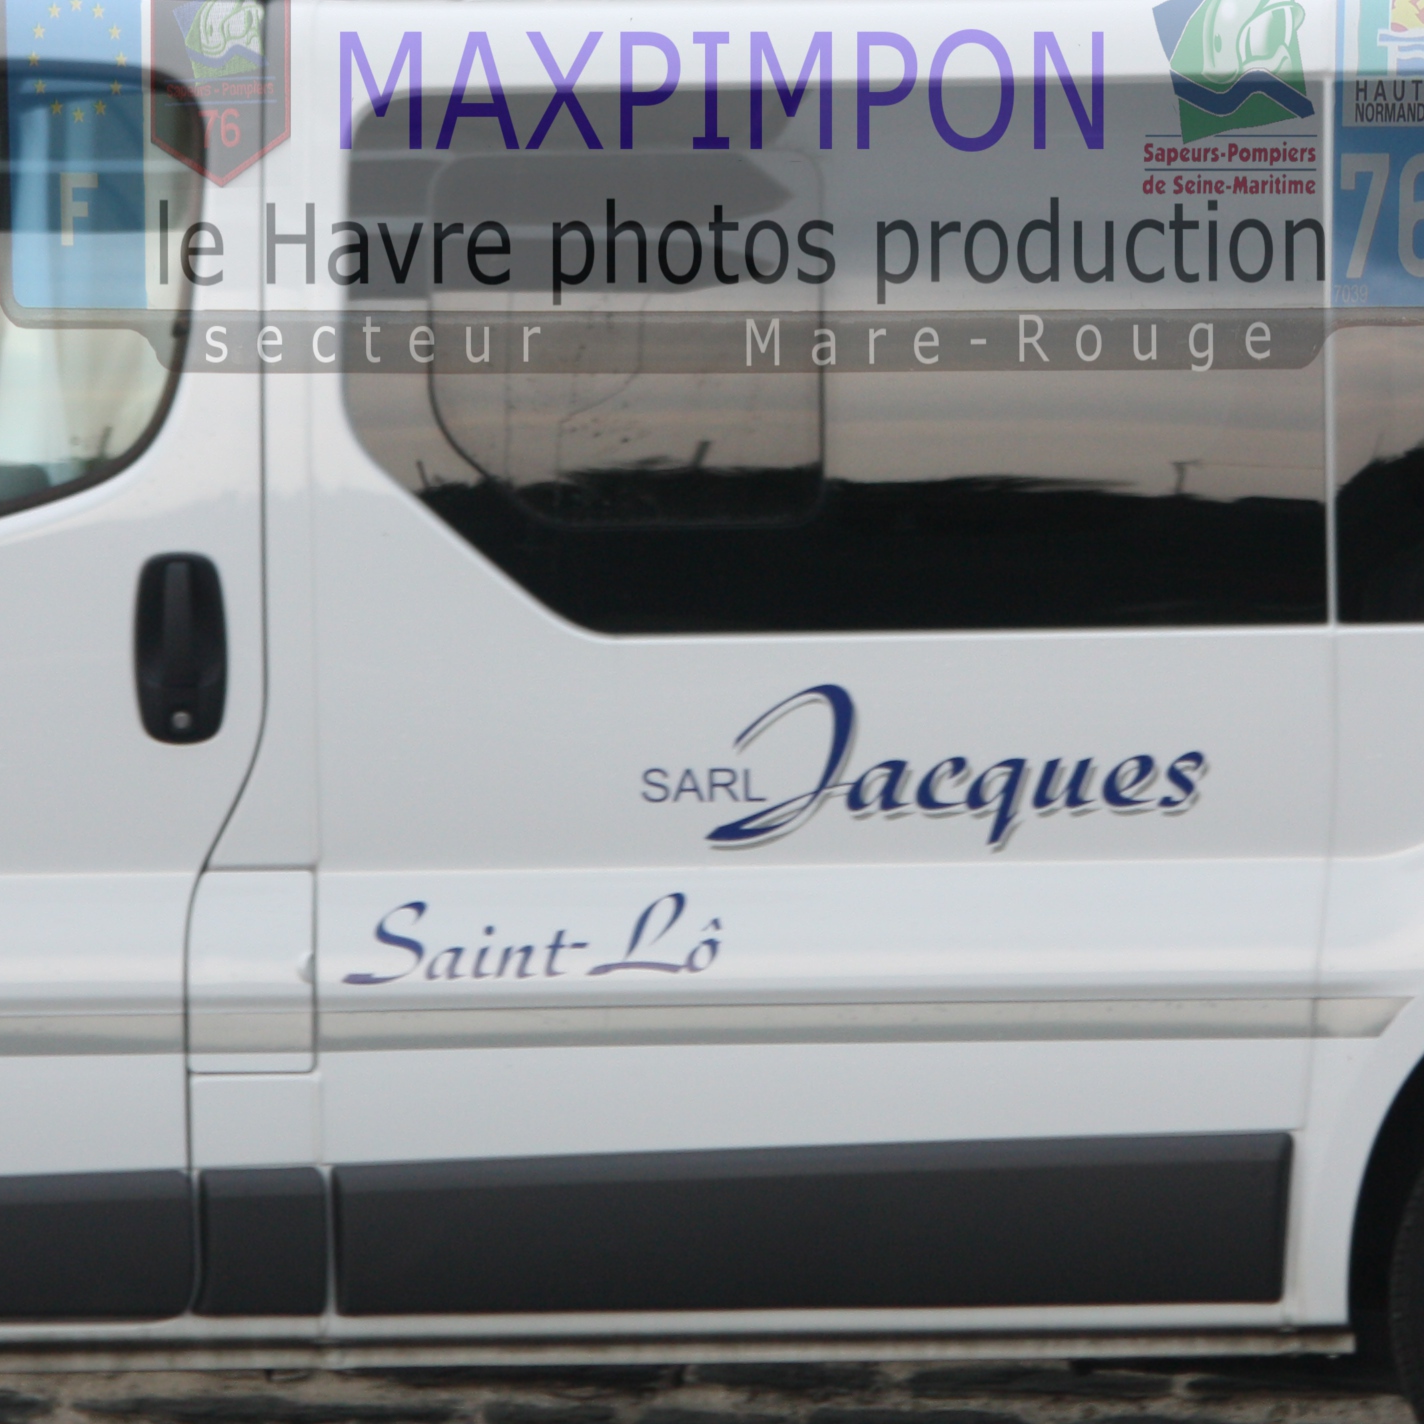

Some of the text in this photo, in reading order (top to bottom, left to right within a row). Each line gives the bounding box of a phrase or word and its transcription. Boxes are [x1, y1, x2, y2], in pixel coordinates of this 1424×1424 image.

[640, 767, 767, 804] SARL
[704, 683, 1209, 847] Jacques
[341, 891, 724, 985] Saint-Lô
